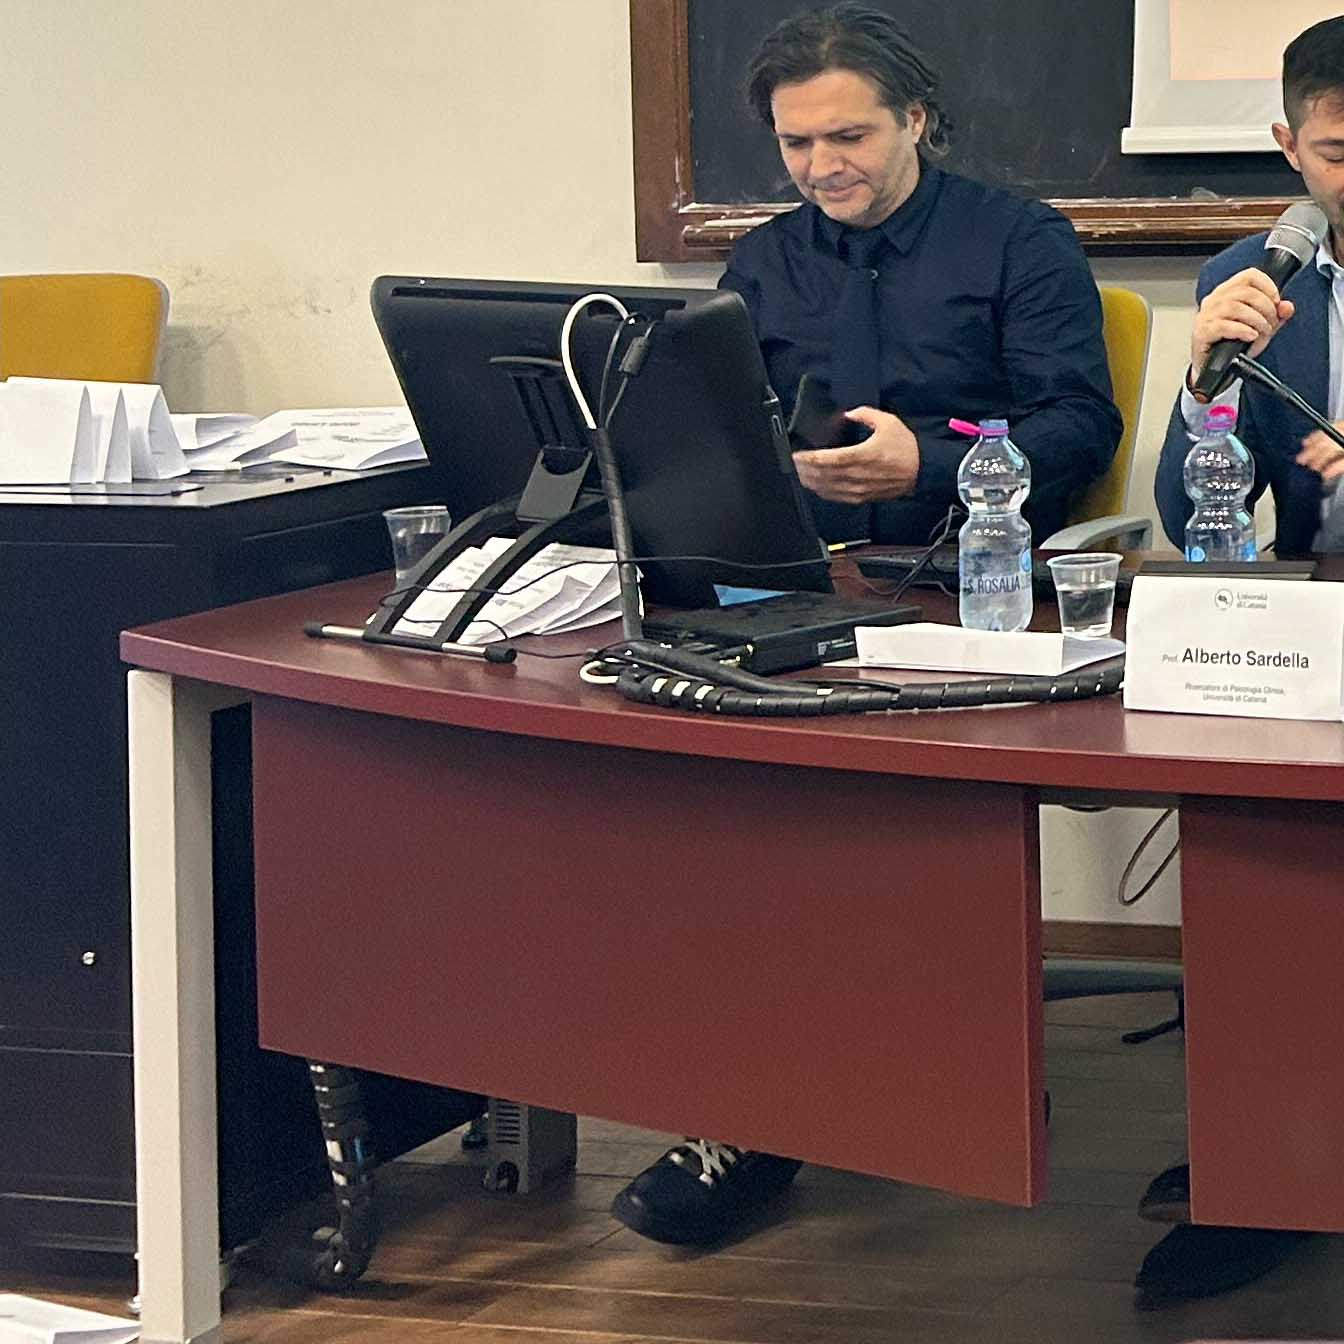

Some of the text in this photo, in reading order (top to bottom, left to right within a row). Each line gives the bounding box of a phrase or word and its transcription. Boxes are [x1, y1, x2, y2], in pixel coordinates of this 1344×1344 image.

[978, 575, 1020, 594] ROSALIA
[1182, 647, 1242, 665] Alberto
[1246, 650, 1310, 669] Sardella
